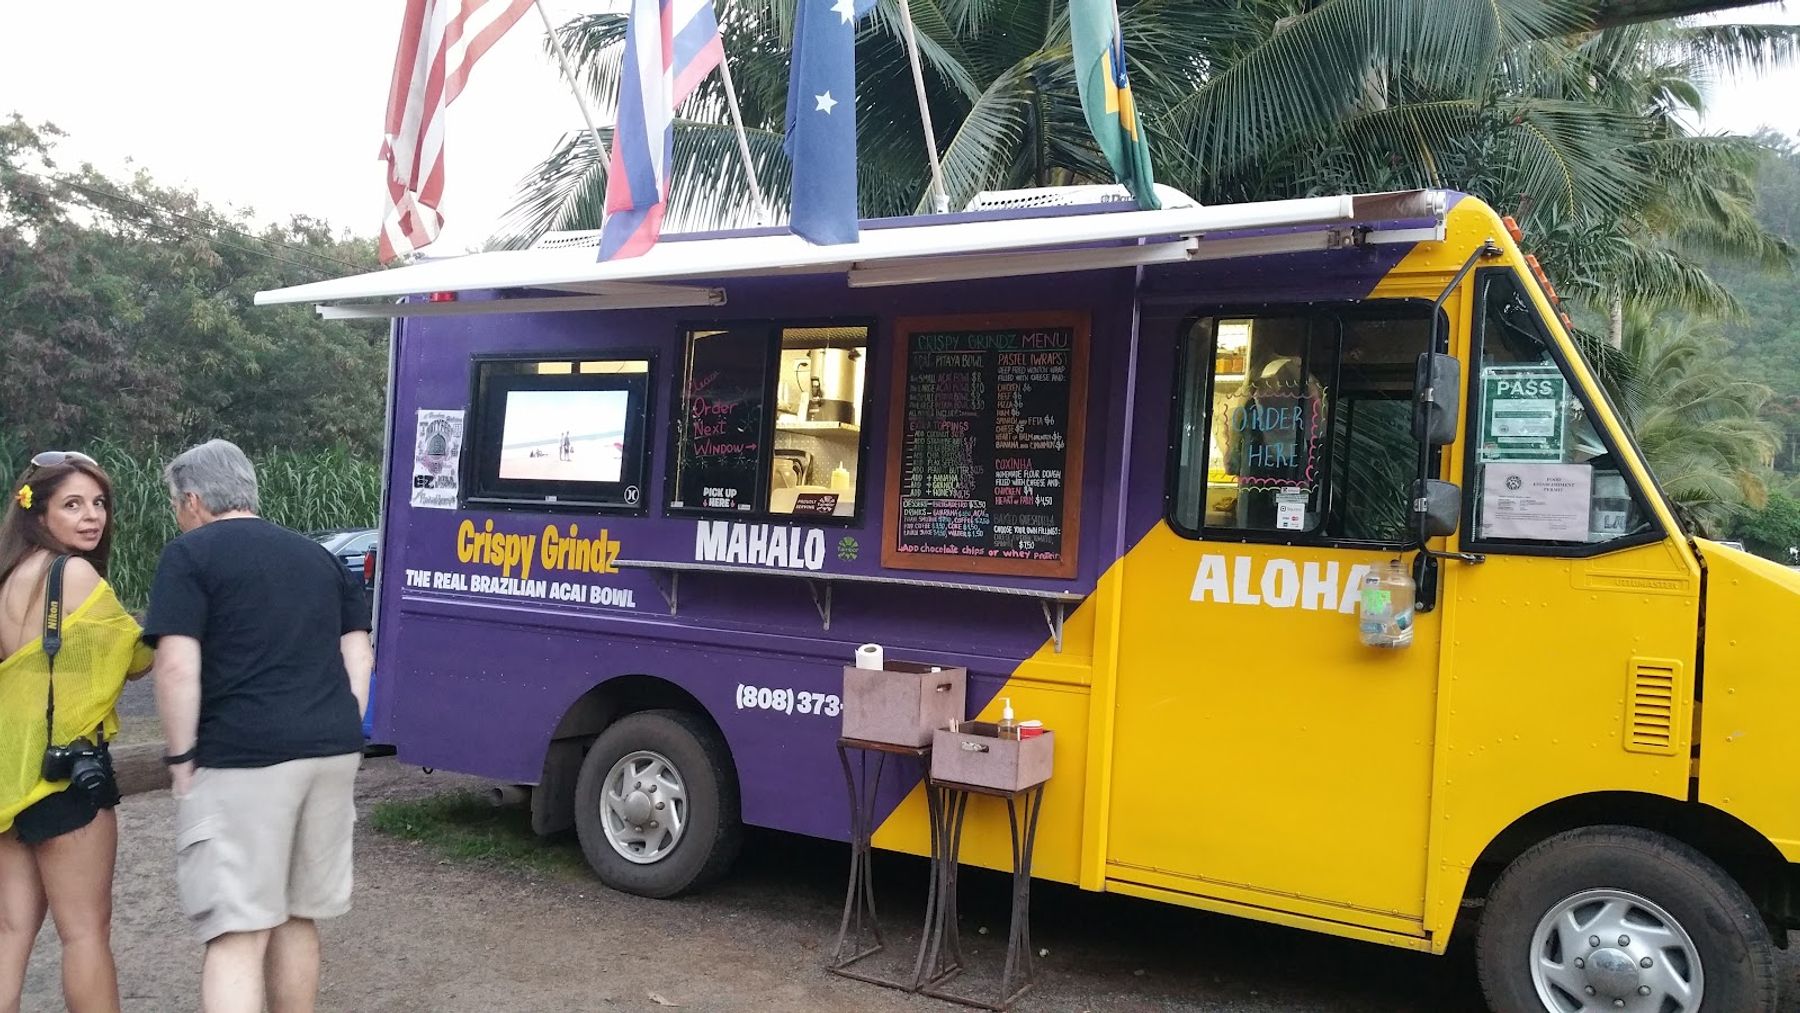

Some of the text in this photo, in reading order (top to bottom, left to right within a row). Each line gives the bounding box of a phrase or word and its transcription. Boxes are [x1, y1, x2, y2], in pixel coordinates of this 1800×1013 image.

[918, 332, 1067, 352] CRISPY GRINDZ MENU
[962, 354, 984, 367] BOWL
[998, 353, 1026, 366] PASTEL
[1013, 391, 1022, 400] $6
[1497, 380, 1553, 396] PASS
[693, 397, 738, 416] Order
[1044, 414, 1055, 426] $6
[1231, 404, 1304, 432] ORDER
[693, 419, 727, 438] Next
[994, 458, 1032, 471] COXINHA
[1248, 442, 1299, 468] HERE
[414, 475, 434, 489] EZ
[703, 487, 738, 499] PICK UP
[708, 498, 731, 508] HERE
[457, 519, 620, 580] Crispy Grindz
[695, 520, 826, 570] MAHALO
[962, 546, 985, 556] chips
[1003, 550, 1031, 560] whey
[405, 569, 636, 608] THE REAL BRAZILIAN ACAI BOWL
[1189, 553, 1371, 614] ALOHA
[47, 600, 59, 630] Nikon
[736, 683, 795, 716] (808)
